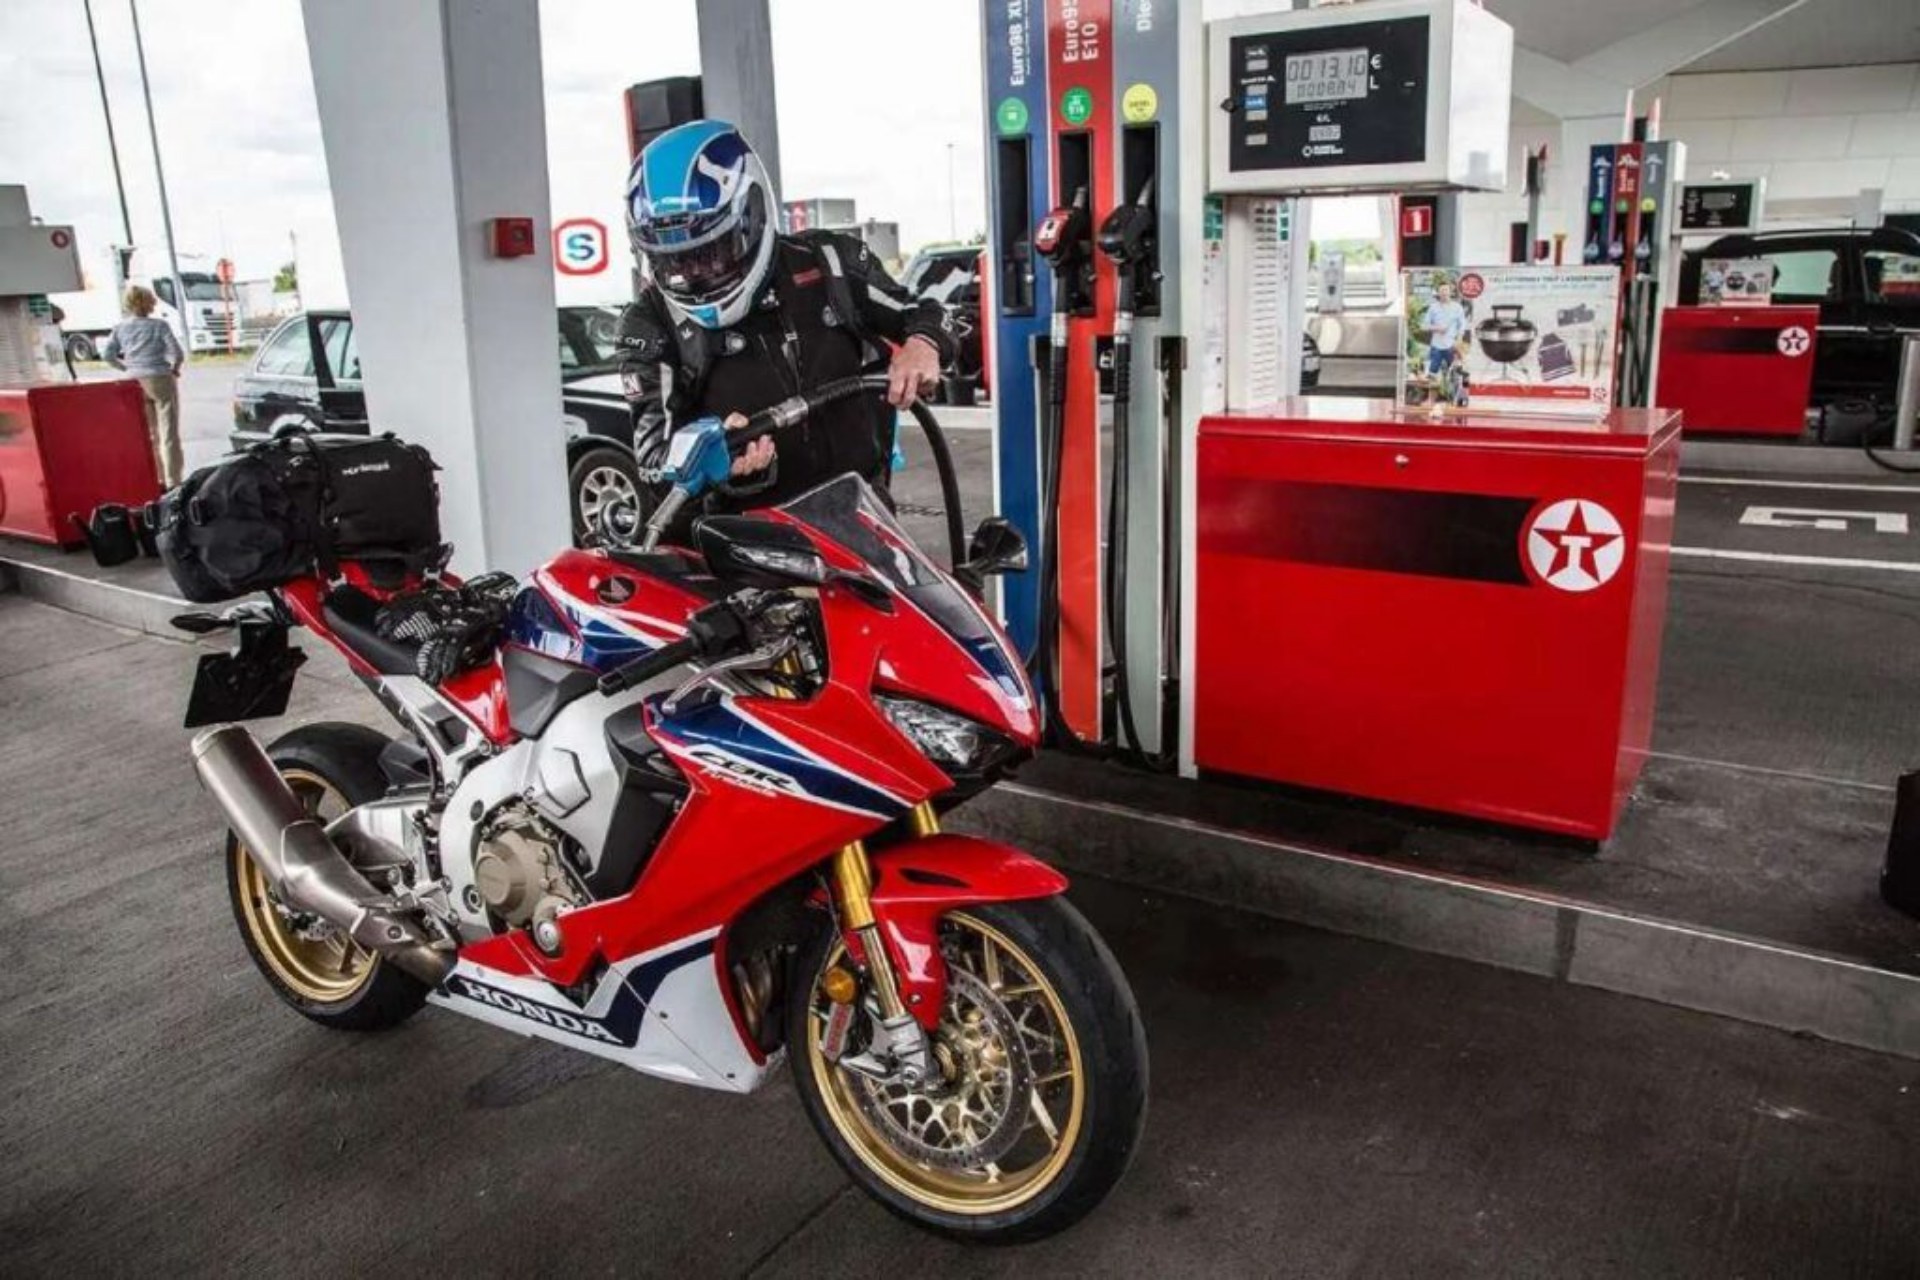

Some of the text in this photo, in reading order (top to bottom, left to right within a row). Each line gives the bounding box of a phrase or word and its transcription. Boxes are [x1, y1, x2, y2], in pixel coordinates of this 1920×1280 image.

[1081, 22, 1099, 60] E10
[1369, 75, 1380, 90] L
[567, 233, 595, 261] S
[457, 978, 624, 1045] HONDA
